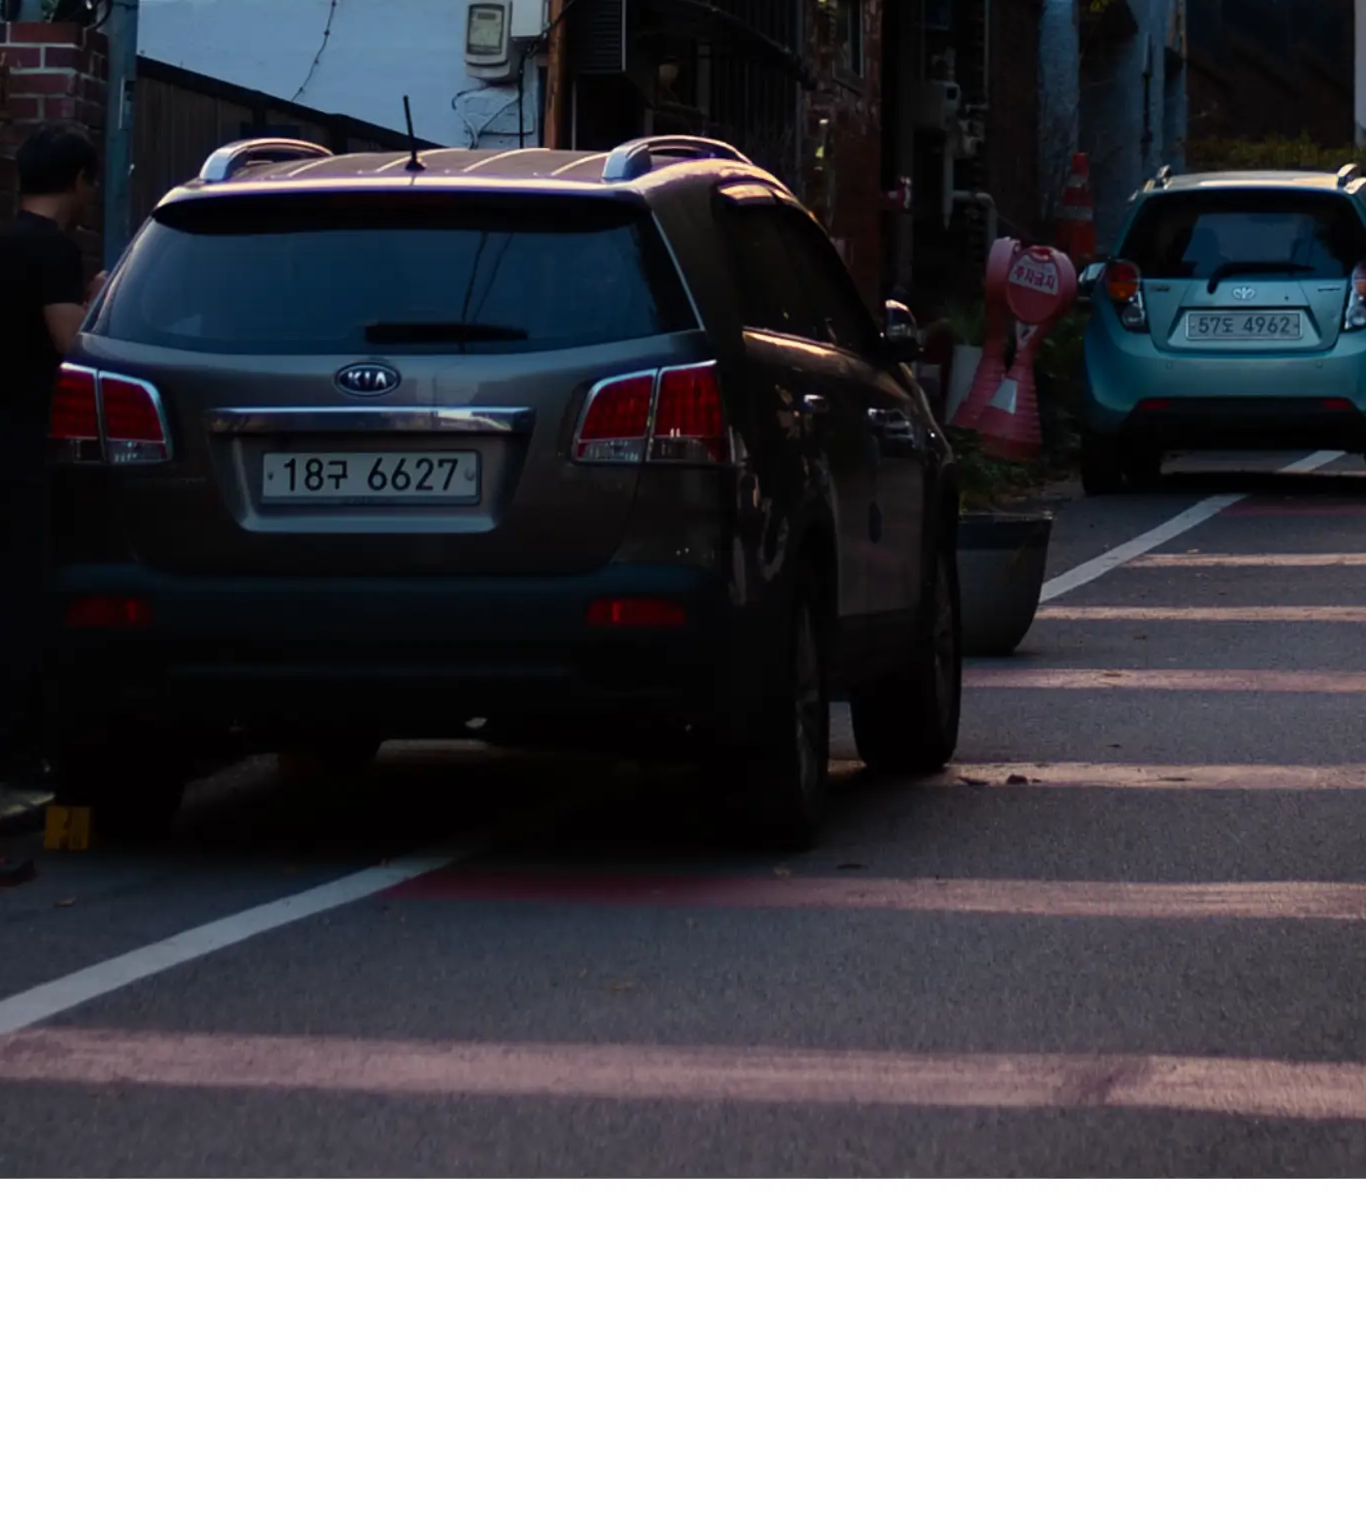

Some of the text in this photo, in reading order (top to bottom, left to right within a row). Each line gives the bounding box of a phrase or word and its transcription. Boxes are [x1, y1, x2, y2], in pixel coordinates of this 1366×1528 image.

[1241, 316, 1291, 336] 4962
[346, 369, 388, 389] KIA
[283, 457, 459, 492] 18구 6627
